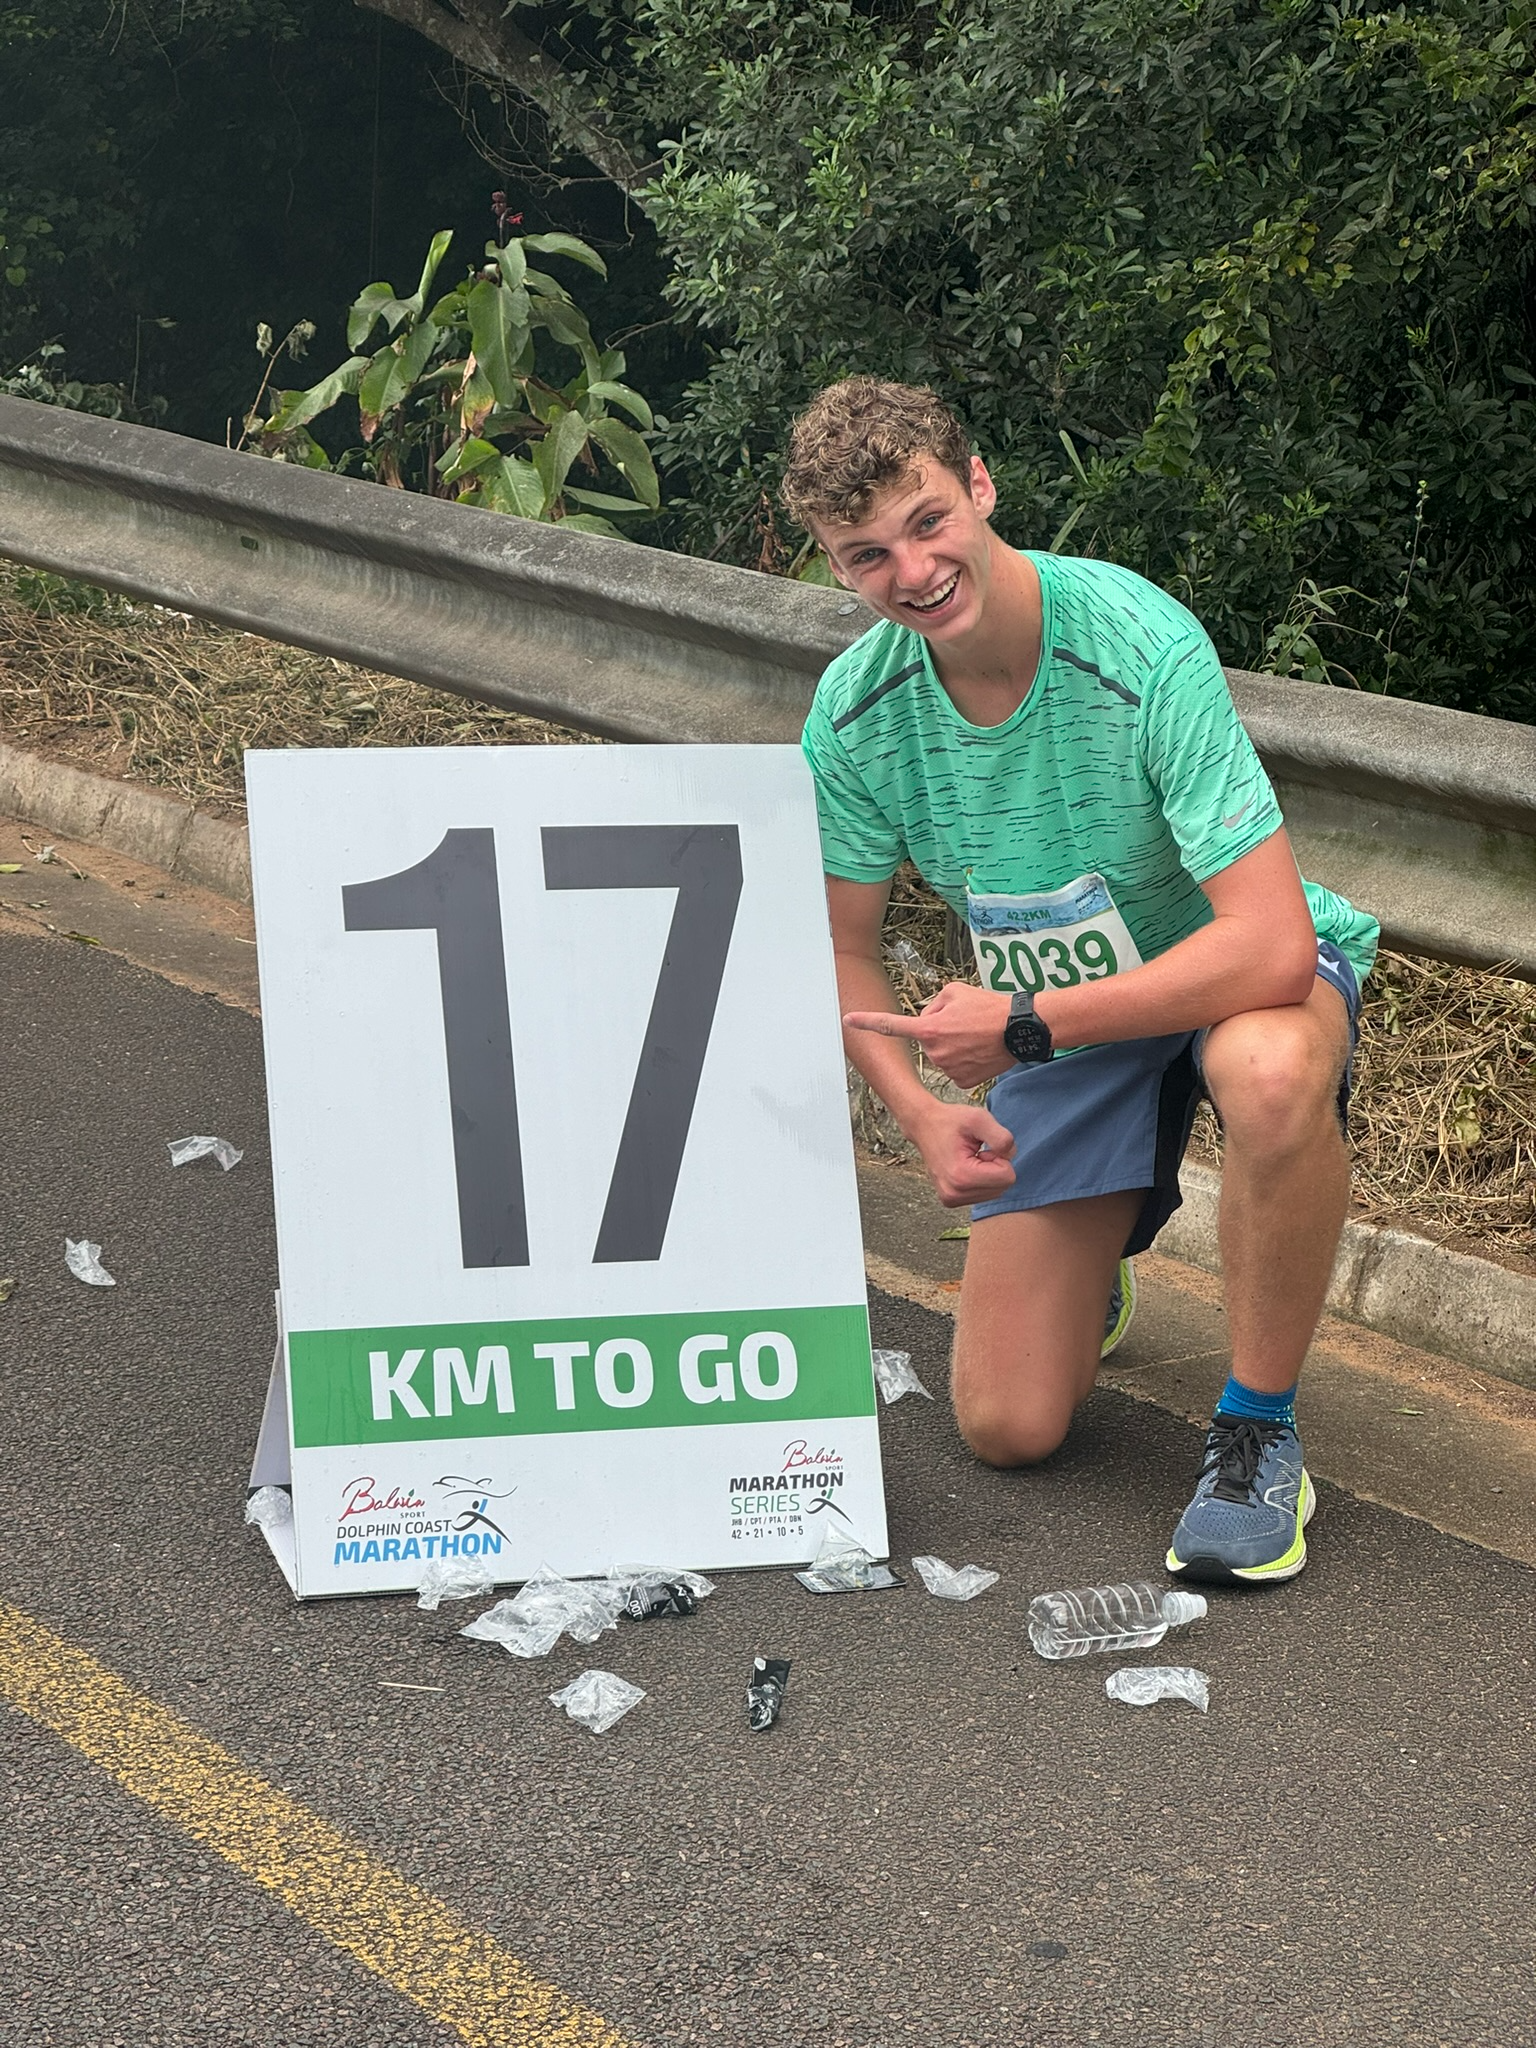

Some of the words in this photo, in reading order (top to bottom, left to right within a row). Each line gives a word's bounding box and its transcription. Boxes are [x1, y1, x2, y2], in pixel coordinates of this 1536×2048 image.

[1007, 909, 1051, 921] 42.2KM
[979, 930, 1118, 993] 2039
[342, 824, 744, 1268] 17
[369, 1345, 515, 1420] KM
[533, 1338, 654, 1411] TO
[678, 1331, 798, 1405] GO
[729, 1472, 844, 1493] MARATHON
[338, 1476, 425, 1522] Balwin
[731, 1494, 800, 1515] SERIES
[400, 1511, 425, 1519] SPORT
[750, 1516, 762, 1525] CPT
[769, 1515, 782, 1524] PTA
[789, 1514, 802, 1522] DBN
[337, 1523, 401, 1539] DOLPHIN
[405, 1519, 453, 1535] COAST
[731, 1529, 742, 1540] 42
[753, 1528, 764, 1538] 21
[777, 1526, 787, 1537] 10
[798, 1525, 804, 1535] 5
[334, 1533, 502, 1565] MARATHON
